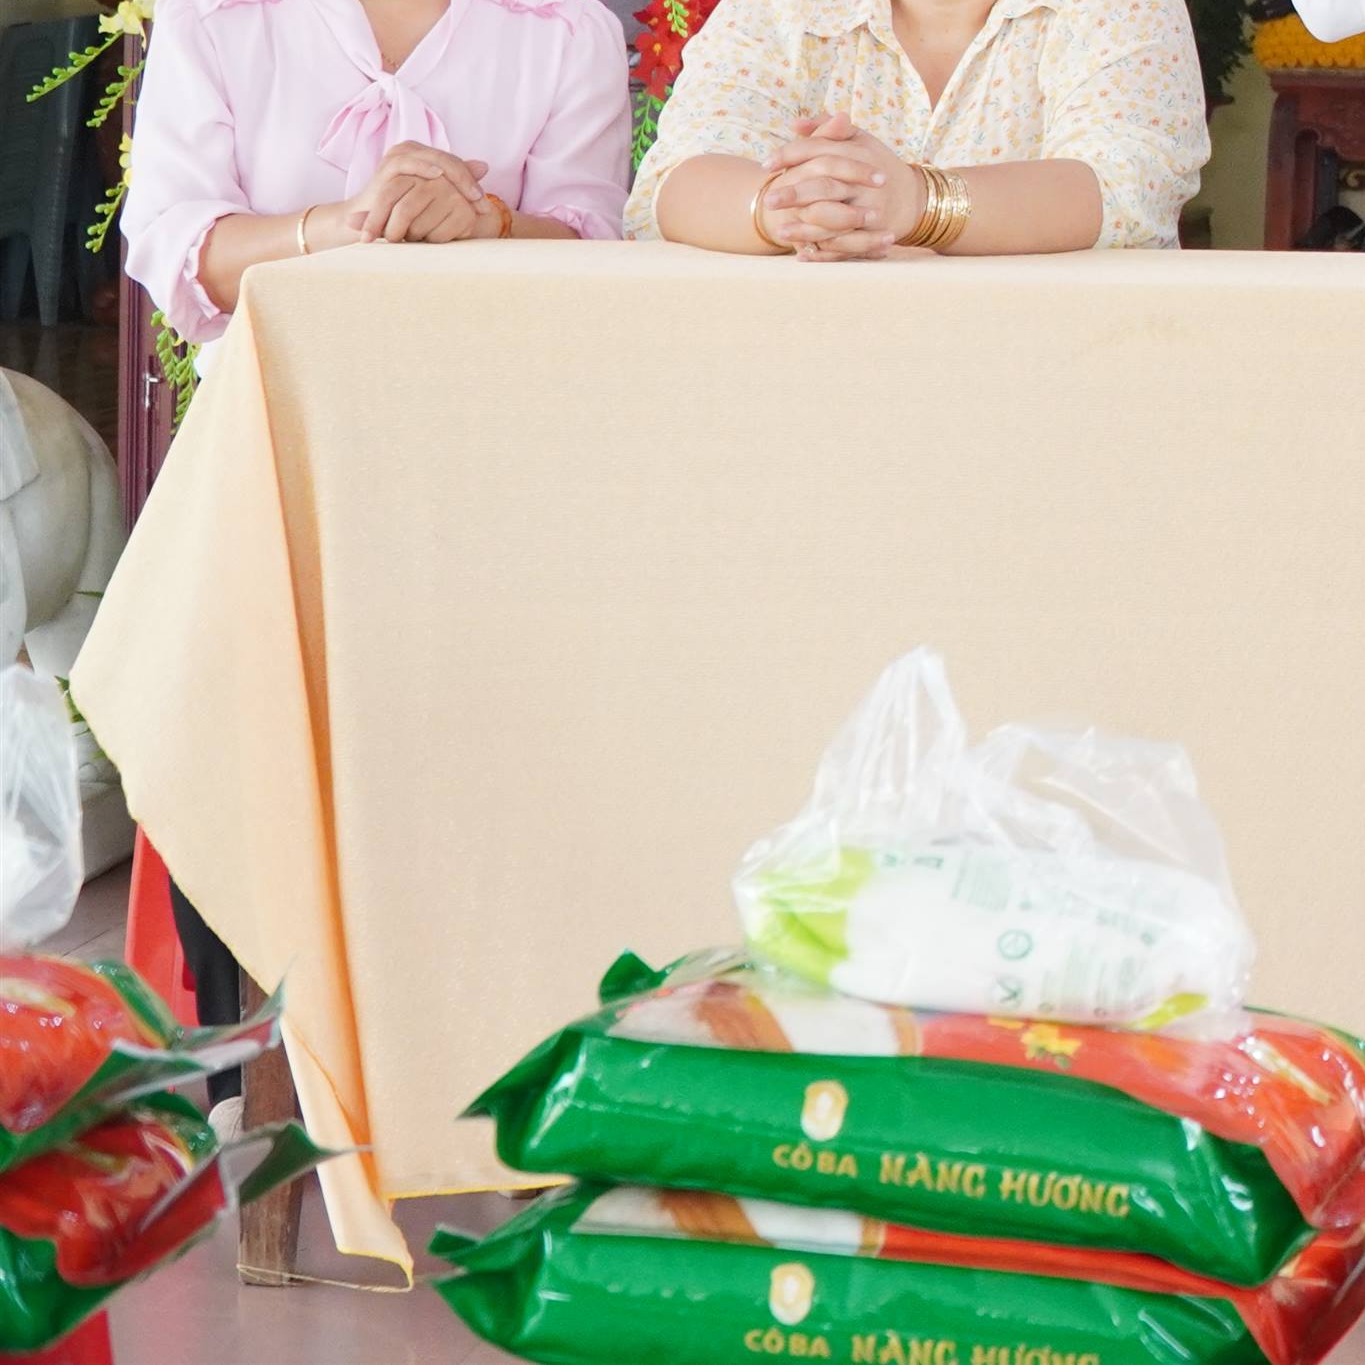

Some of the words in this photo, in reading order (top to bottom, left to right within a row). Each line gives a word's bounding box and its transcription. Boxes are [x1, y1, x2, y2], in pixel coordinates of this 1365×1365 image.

[879, 1151, 987, 1198] NÀNG
[998, 1169, 1130, 1218] HƯƠNG
[850, 1329, 958, 1365] NÀNG
